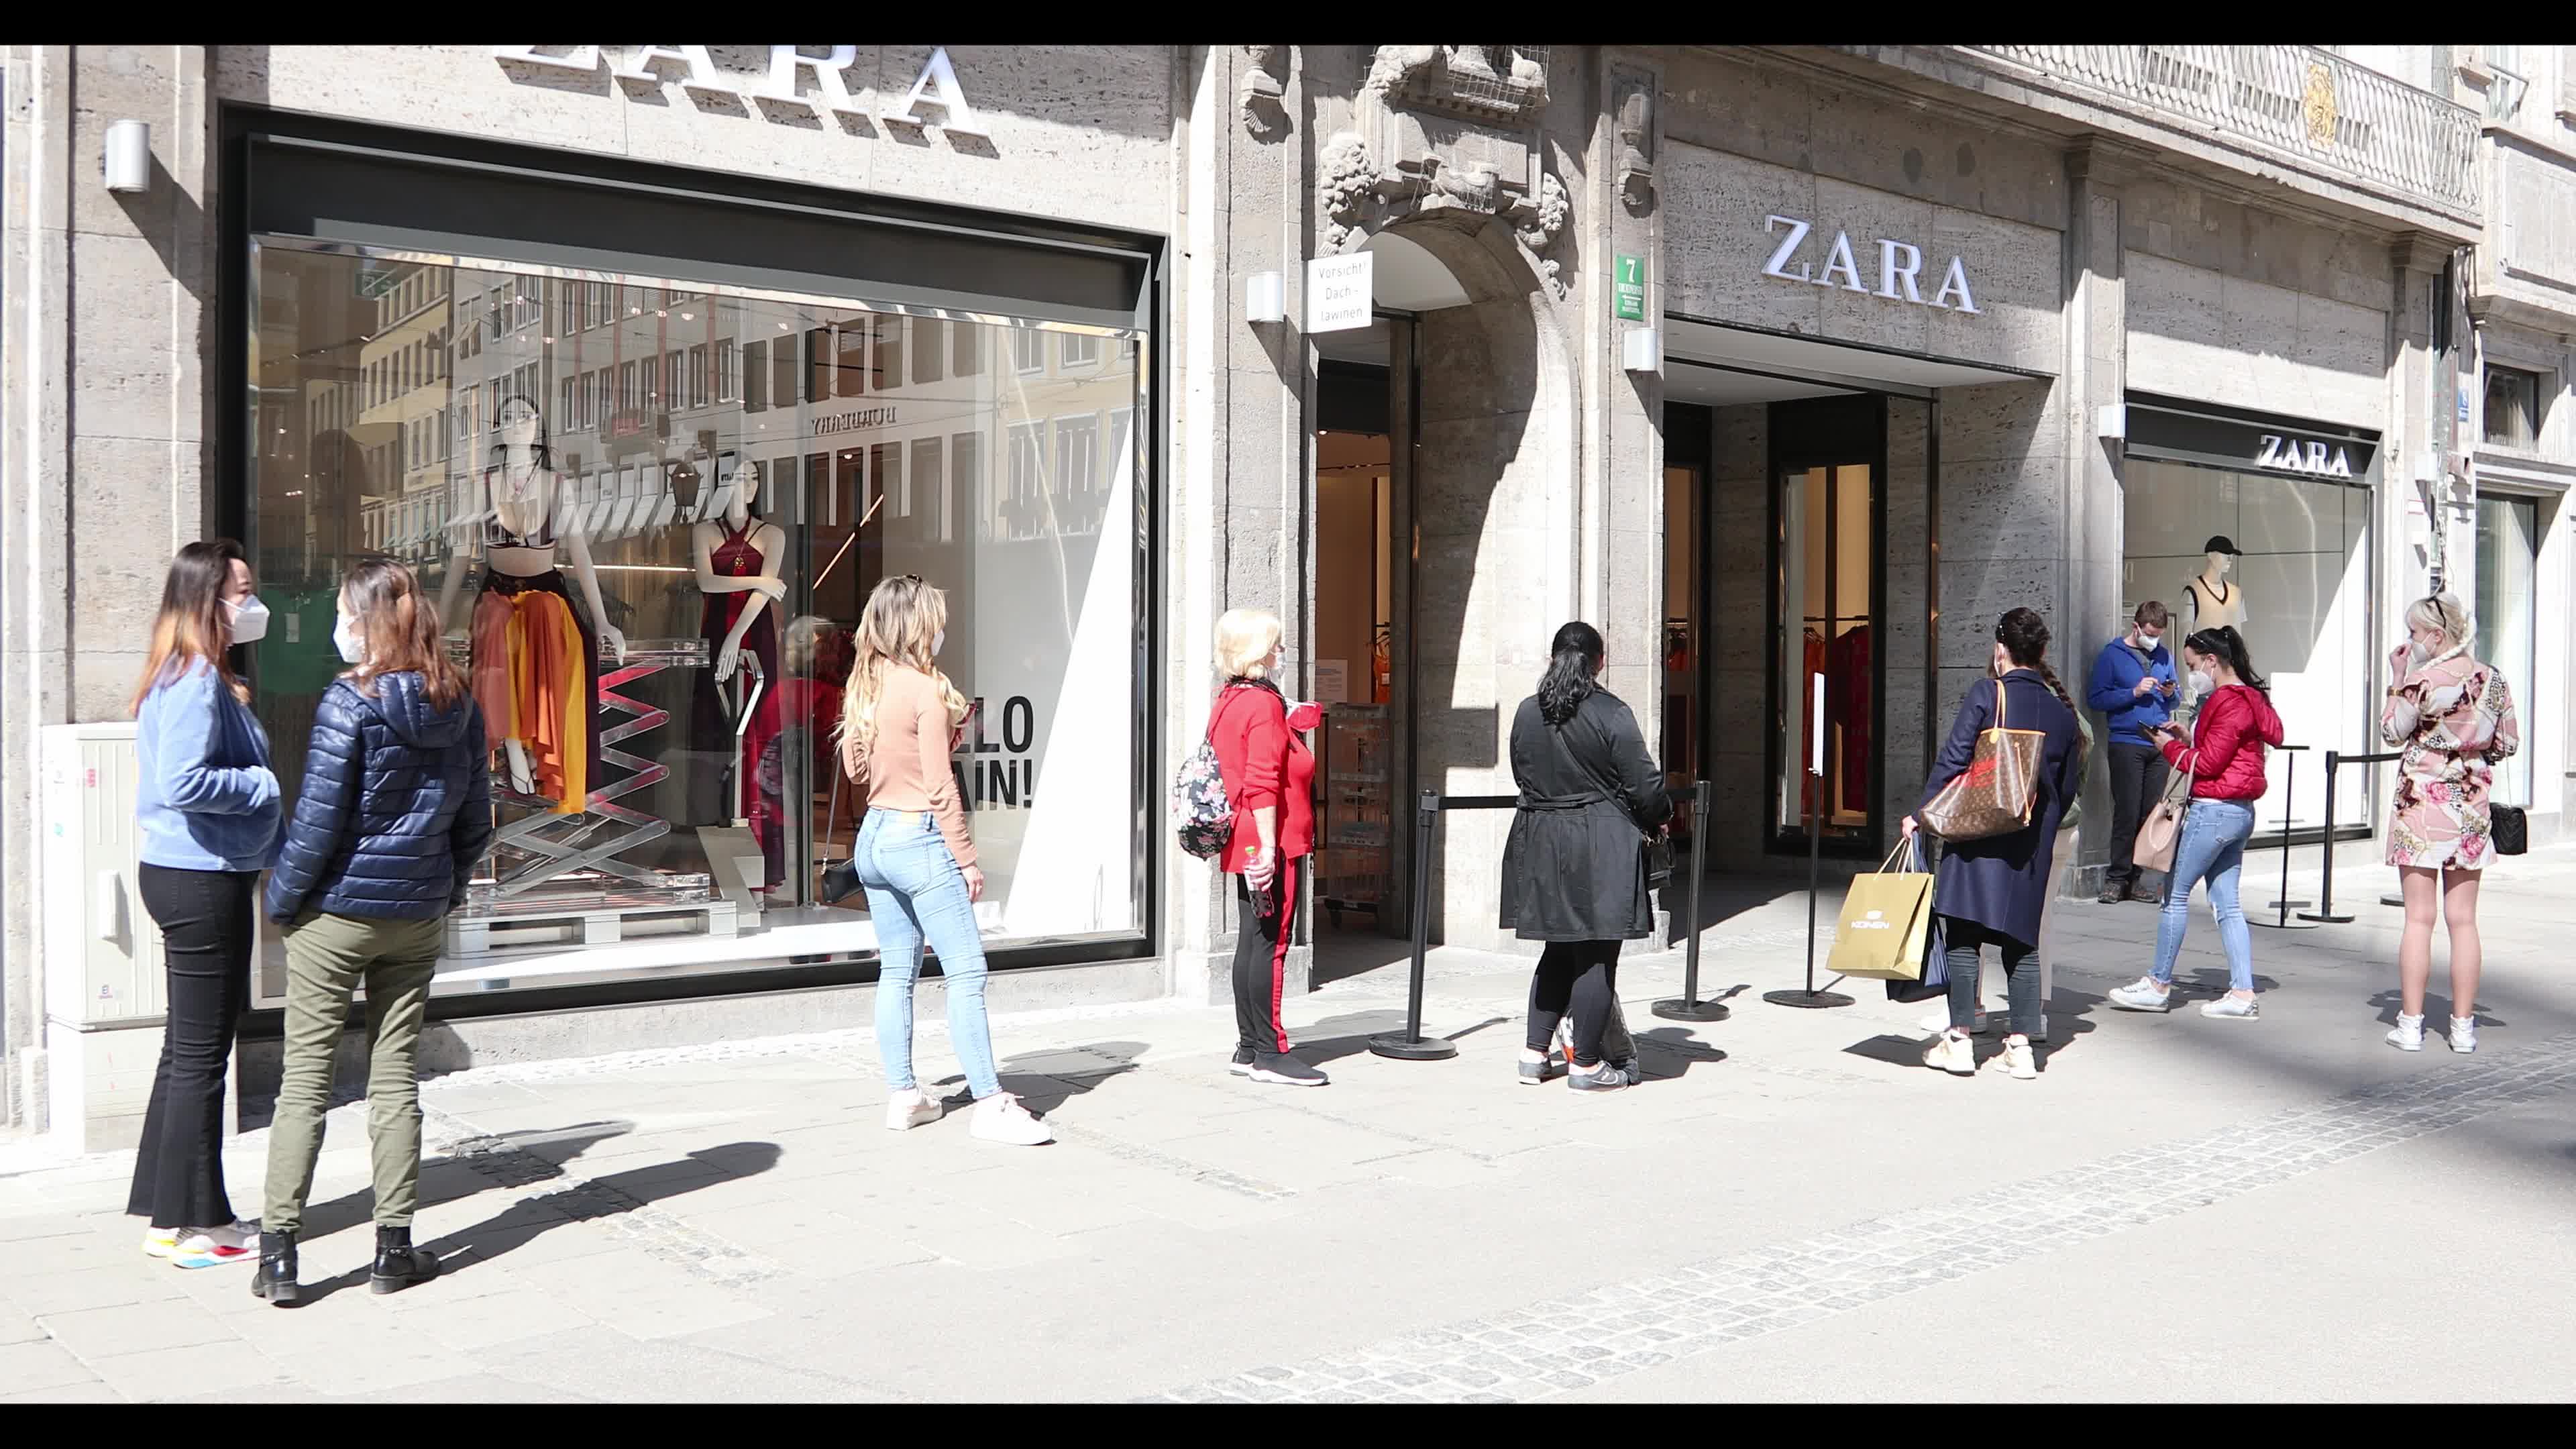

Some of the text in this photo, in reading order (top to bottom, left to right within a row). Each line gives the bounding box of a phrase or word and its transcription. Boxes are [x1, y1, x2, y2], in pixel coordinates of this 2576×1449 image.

[493, 45, 989, 136] RA
[1626, 258, 1635, 282] 7
[1761, 215, 1980, 313] ZARA
[2257, 435, 2353, 478] ZARA
[953, 696, 1033, 753] LO
